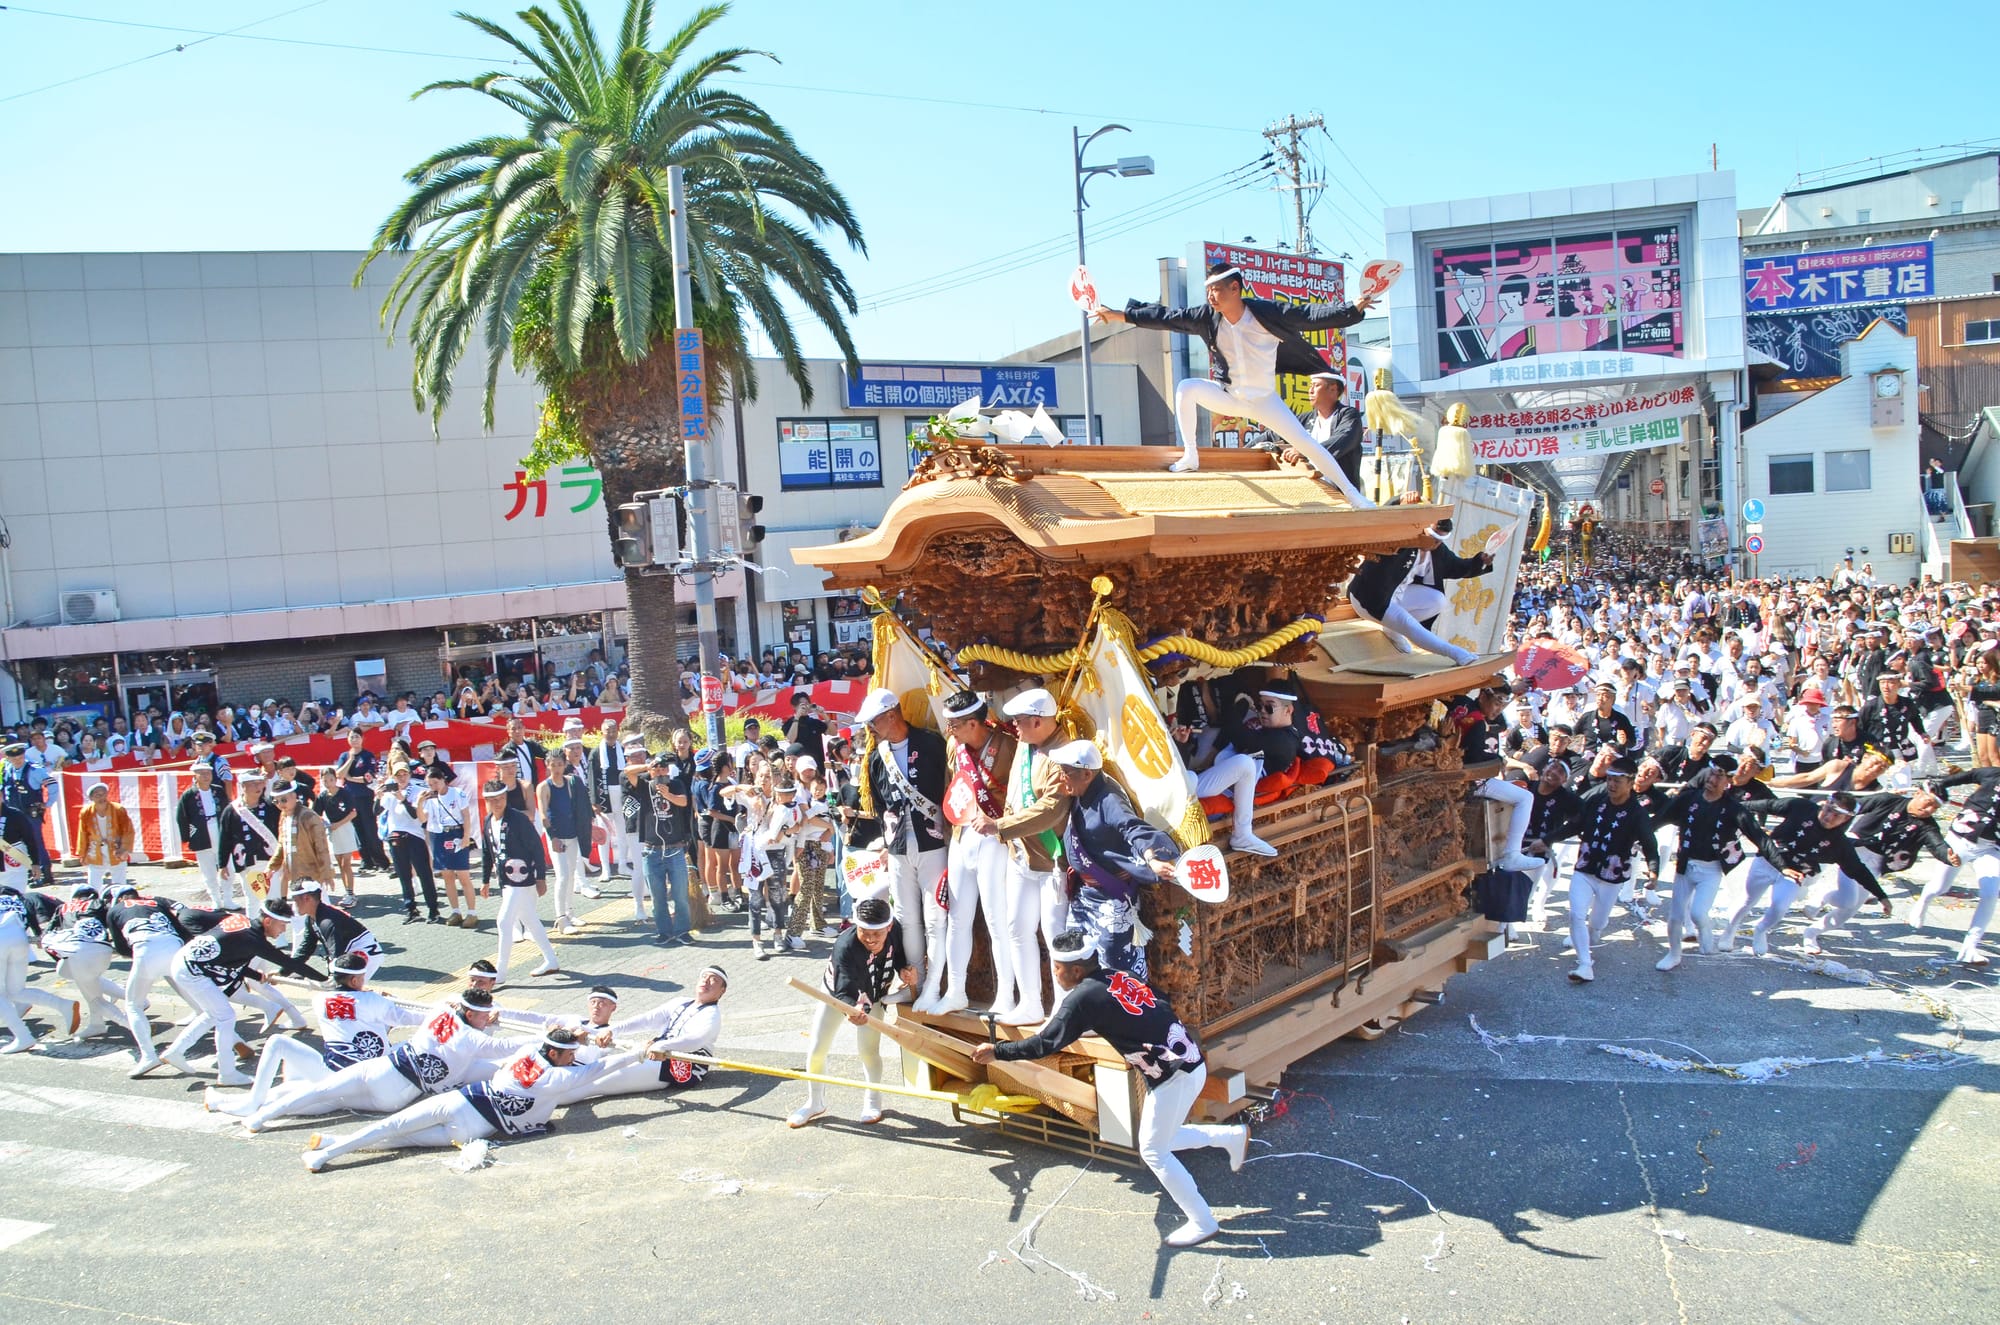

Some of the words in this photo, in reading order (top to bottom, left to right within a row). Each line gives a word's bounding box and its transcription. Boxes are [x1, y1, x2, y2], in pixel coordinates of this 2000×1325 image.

[1229, 250, 1263, 267] 生ビール
[1266, 256, 1305, 273] ハイボール
[1747, 261, 1794, 306] 本
[1799, 263, 1927, 302] 木下書店
[677, 331, 705, 437] 歩車分離式
[996, 371, 1040, 381] 全科目対応
[1489, 357, 1634, 383] 岸和田駅前通商店街
[987, 381, 1045, 405] Axis
[1463, 386, 1695, 429] と勇壮を誇る明るく楽しいだんじり祭
[1585, 417, 1680, 449] テレビ岸和田
[808, 447, 875, 470] 能開の
